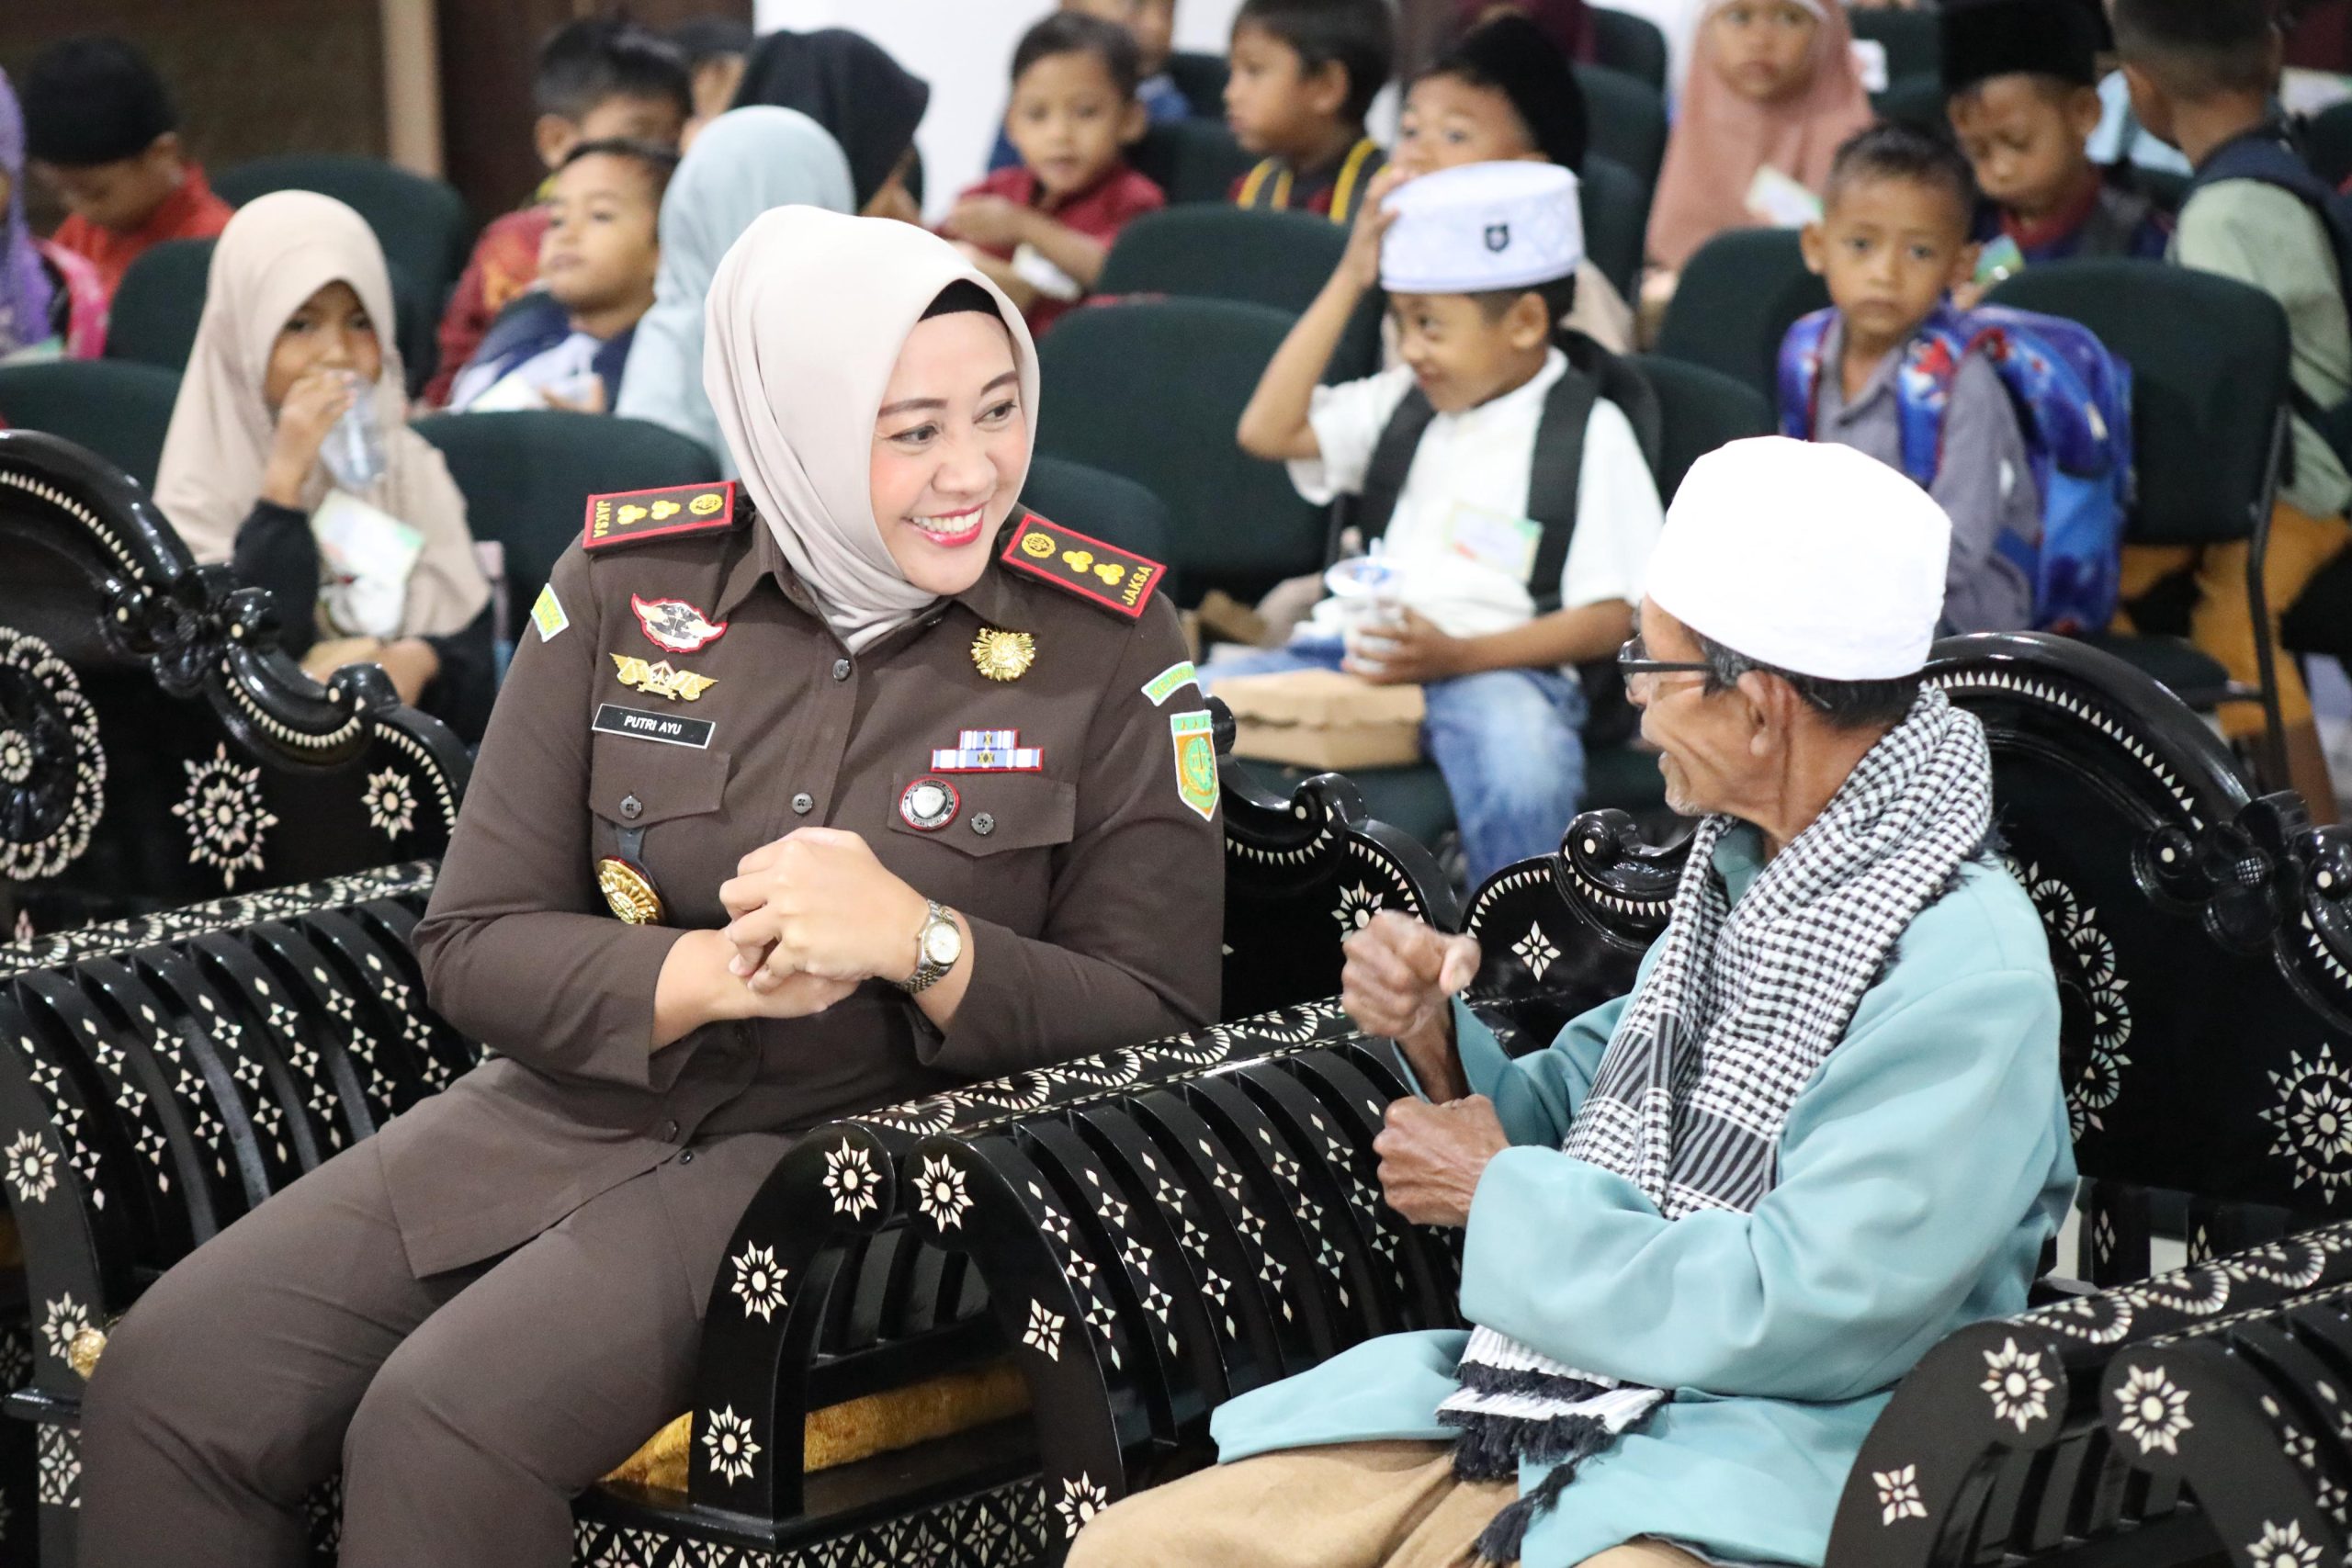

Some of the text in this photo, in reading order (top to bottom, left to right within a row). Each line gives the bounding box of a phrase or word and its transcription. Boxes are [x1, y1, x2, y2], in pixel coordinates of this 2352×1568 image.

[593, 500, 611, 538] JAKSA
[1122, 566, 1153, 605] JAKSA
[624, 715, 683, 735] PUTRI AYU
